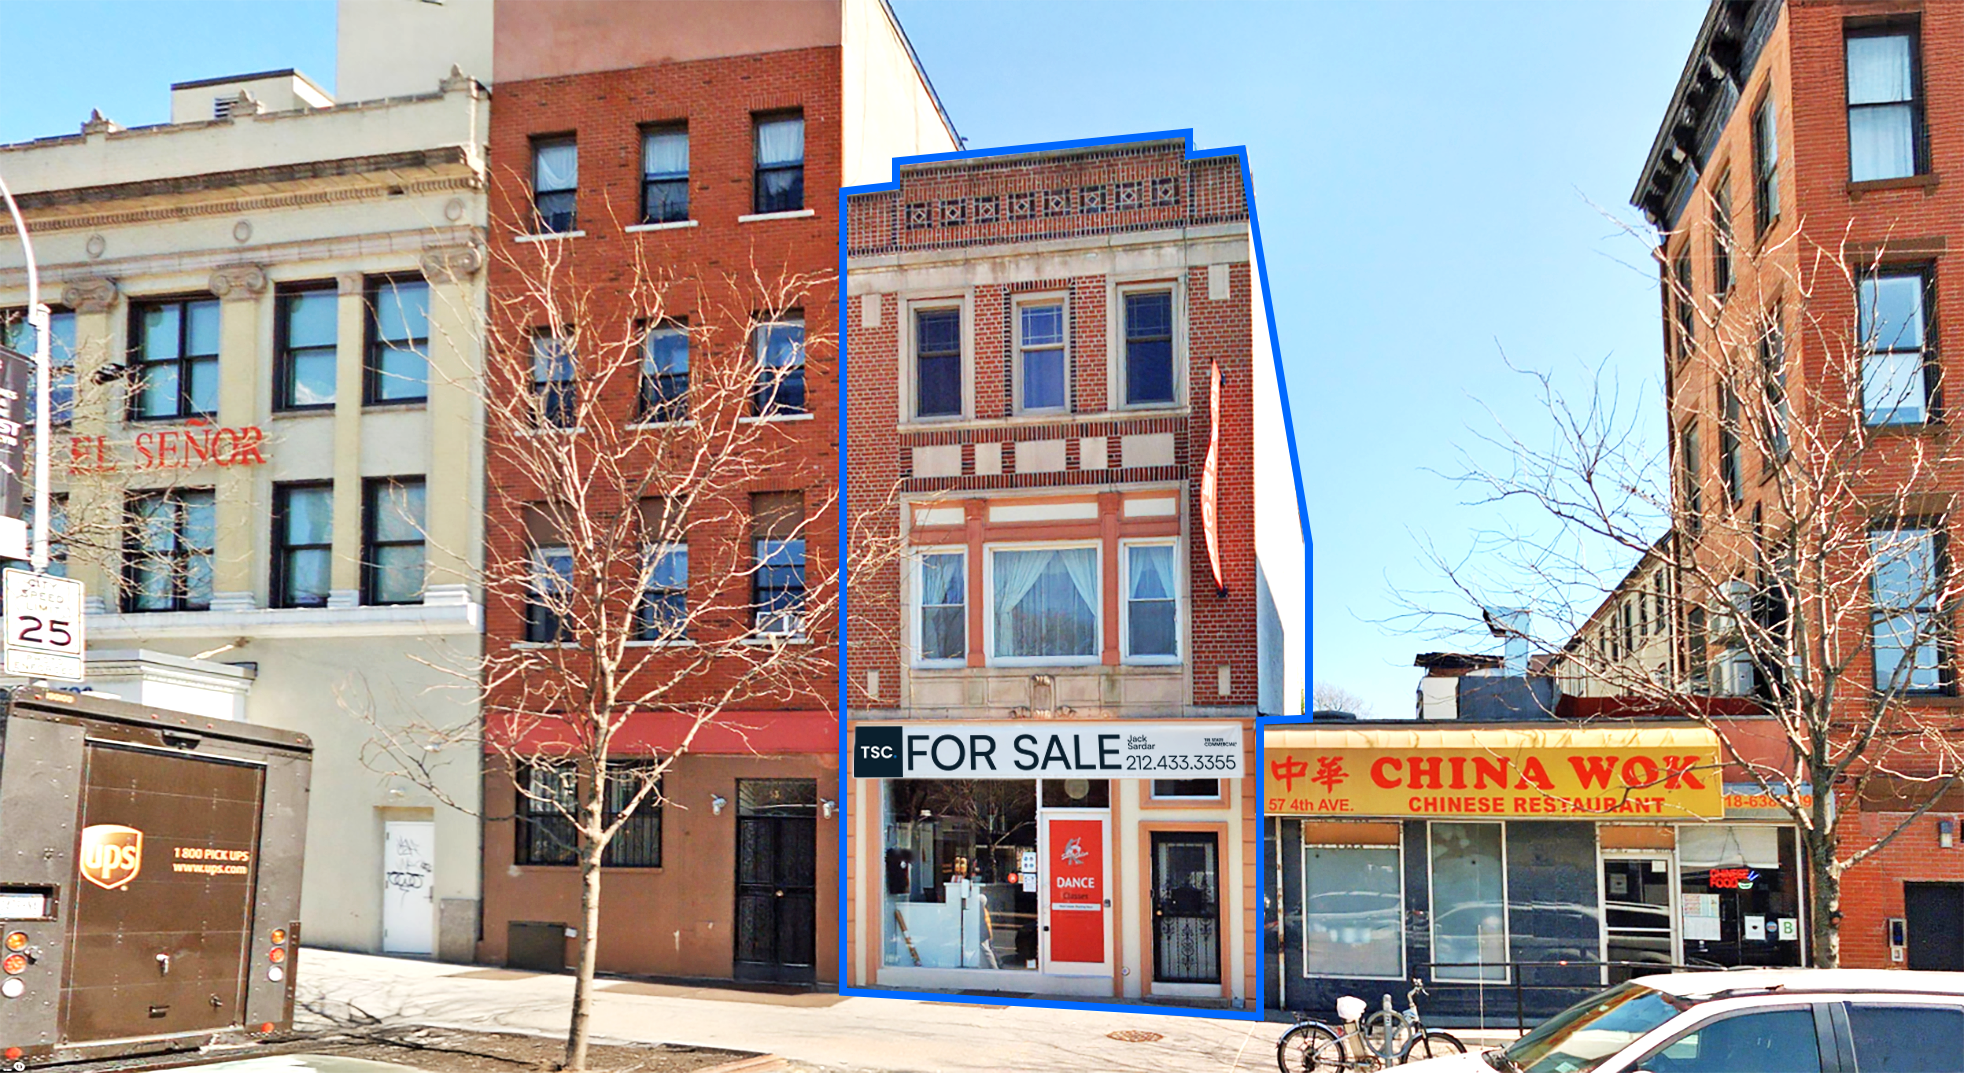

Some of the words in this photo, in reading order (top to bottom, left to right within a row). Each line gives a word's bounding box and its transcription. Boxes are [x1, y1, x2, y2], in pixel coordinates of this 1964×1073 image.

[69, 435, 118, 475] EL
[134, 417, 267, 470] SEÑOR
[18, 615, 72, 646] 25
[1127, 734, 1148, 743] Jack
[1127, 742, 1156, 751] Sardar
[907, 734, 997, 771] FOR
[1013, 734, 1123, 771] SALE
[1126, 754, 1237, 771] 212.433.3355
[1271, 755, 1350, 794] 中華
[1370, 756, 1556, 790] CHINA
[1567, 755, 1706, 791] WOK
[1268, 798, 1286, 811] 57
[1290, 798, 1314, 811] 4th
[1318, 798, 1354, 812] AVE.
[1408, 796, 1505, 813] CHINESE
[1513, 796, 1666, 814] RESTAURANT
[85, 844, 137, 879] ups
[174, 847, 180, 858] 1
[181, 847, 203, 859] 800
[204, 848, 229, 860] PICK
[229, 850, 250, 862] UPS
[172, 863, 248, 876] www.ups.com
[1056, 876, 1095, 889] DANCE
[1709, 878, 1738, 889] FOOD
[1783, 921, 1793, 934] B
